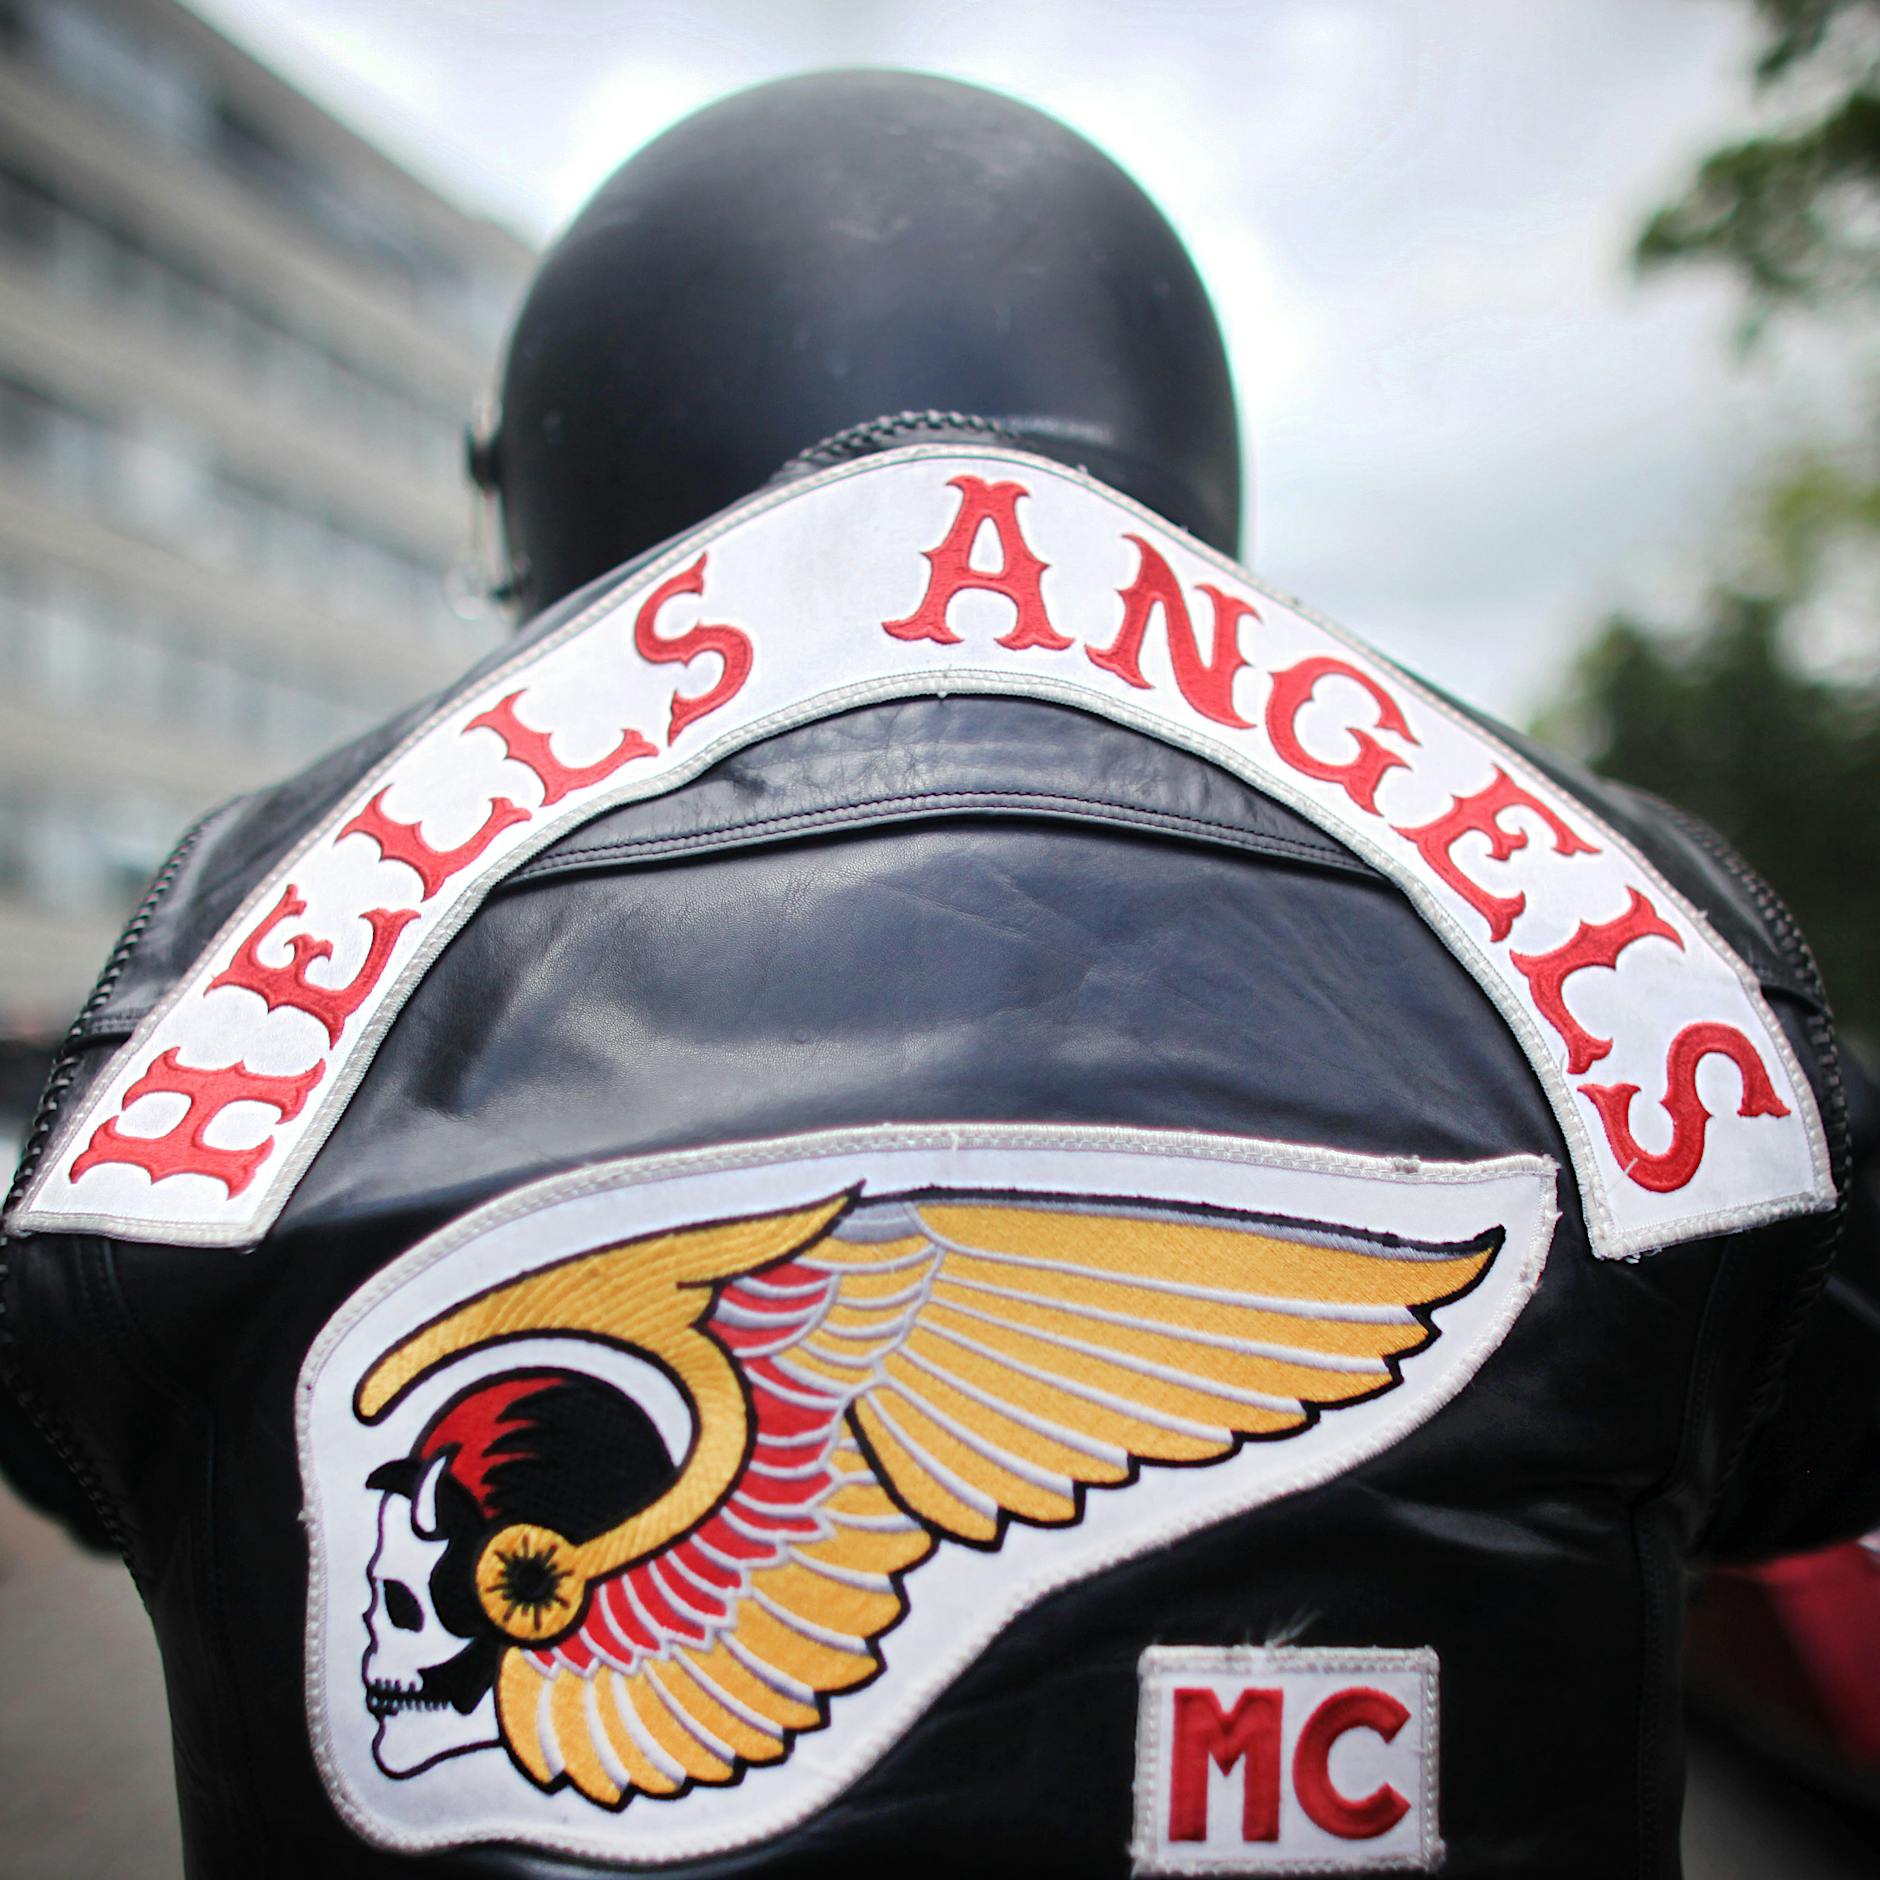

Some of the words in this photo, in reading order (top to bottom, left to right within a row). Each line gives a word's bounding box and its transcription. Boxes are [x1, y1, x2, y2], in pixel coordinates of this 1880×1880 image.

[70, 551, 754, 1199] HELLS
[882, 475, 1791, 1194] ANGELS
[1168, 1687, 1412, 1843] MC
